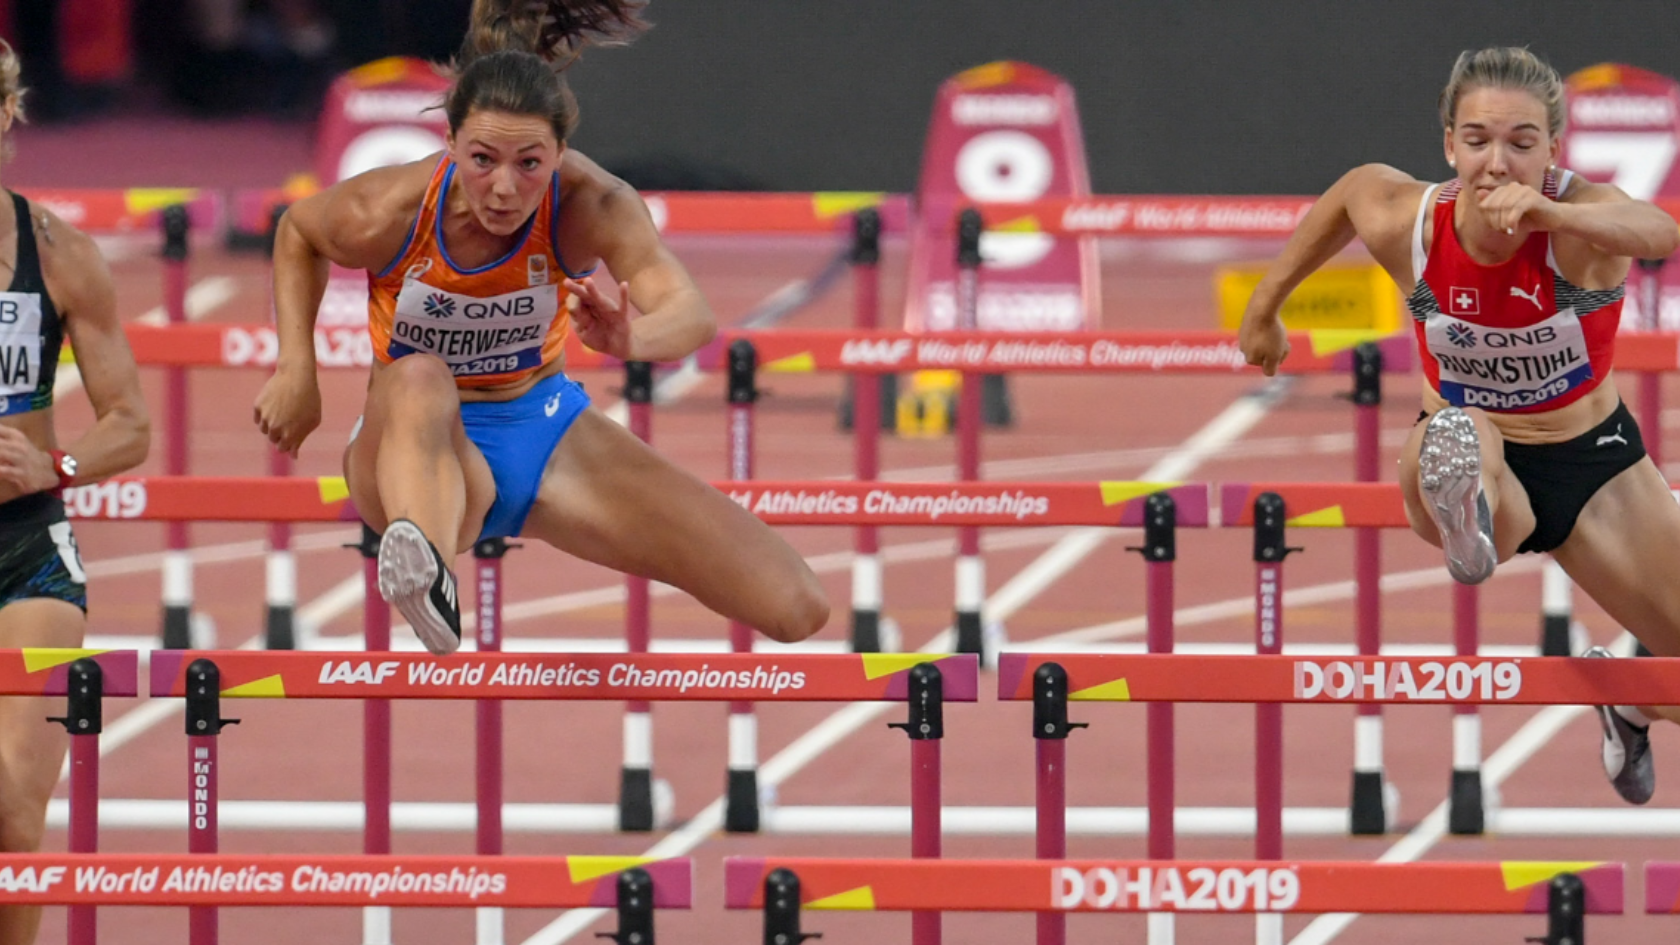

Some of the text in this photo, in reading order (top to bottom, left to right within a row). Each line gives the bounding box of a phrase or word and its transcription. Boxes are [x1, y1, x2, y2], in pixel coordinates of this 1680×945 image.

[463, 296, 535, 319] QNB
[841, 338, 912, 365] IAAF
[917, 338, 988, 365] World
[988, 338, 1087, 366] Athletics
[1483, 326, 1557, 348] QNB
[1435, 346, 1581, 384] RUCKSTUHL
[1463, 378, 1570, 409] DOHA2019
[753, 490, 858, 515] Athletics
[863, 490, 1048, 520] Championships
[318, 661, 806, 694] IAAF World Athletics Championships
[1293, 660, 1522, 699] DOHA2019
[194, 761, 210, 829] MONDO
[74, 866, 157, 893] World
[162, 866, 284, 893] Athletics
[290, 866, 506, 899] Championships
[1050, 867, 1301, 910] DOHA2019
